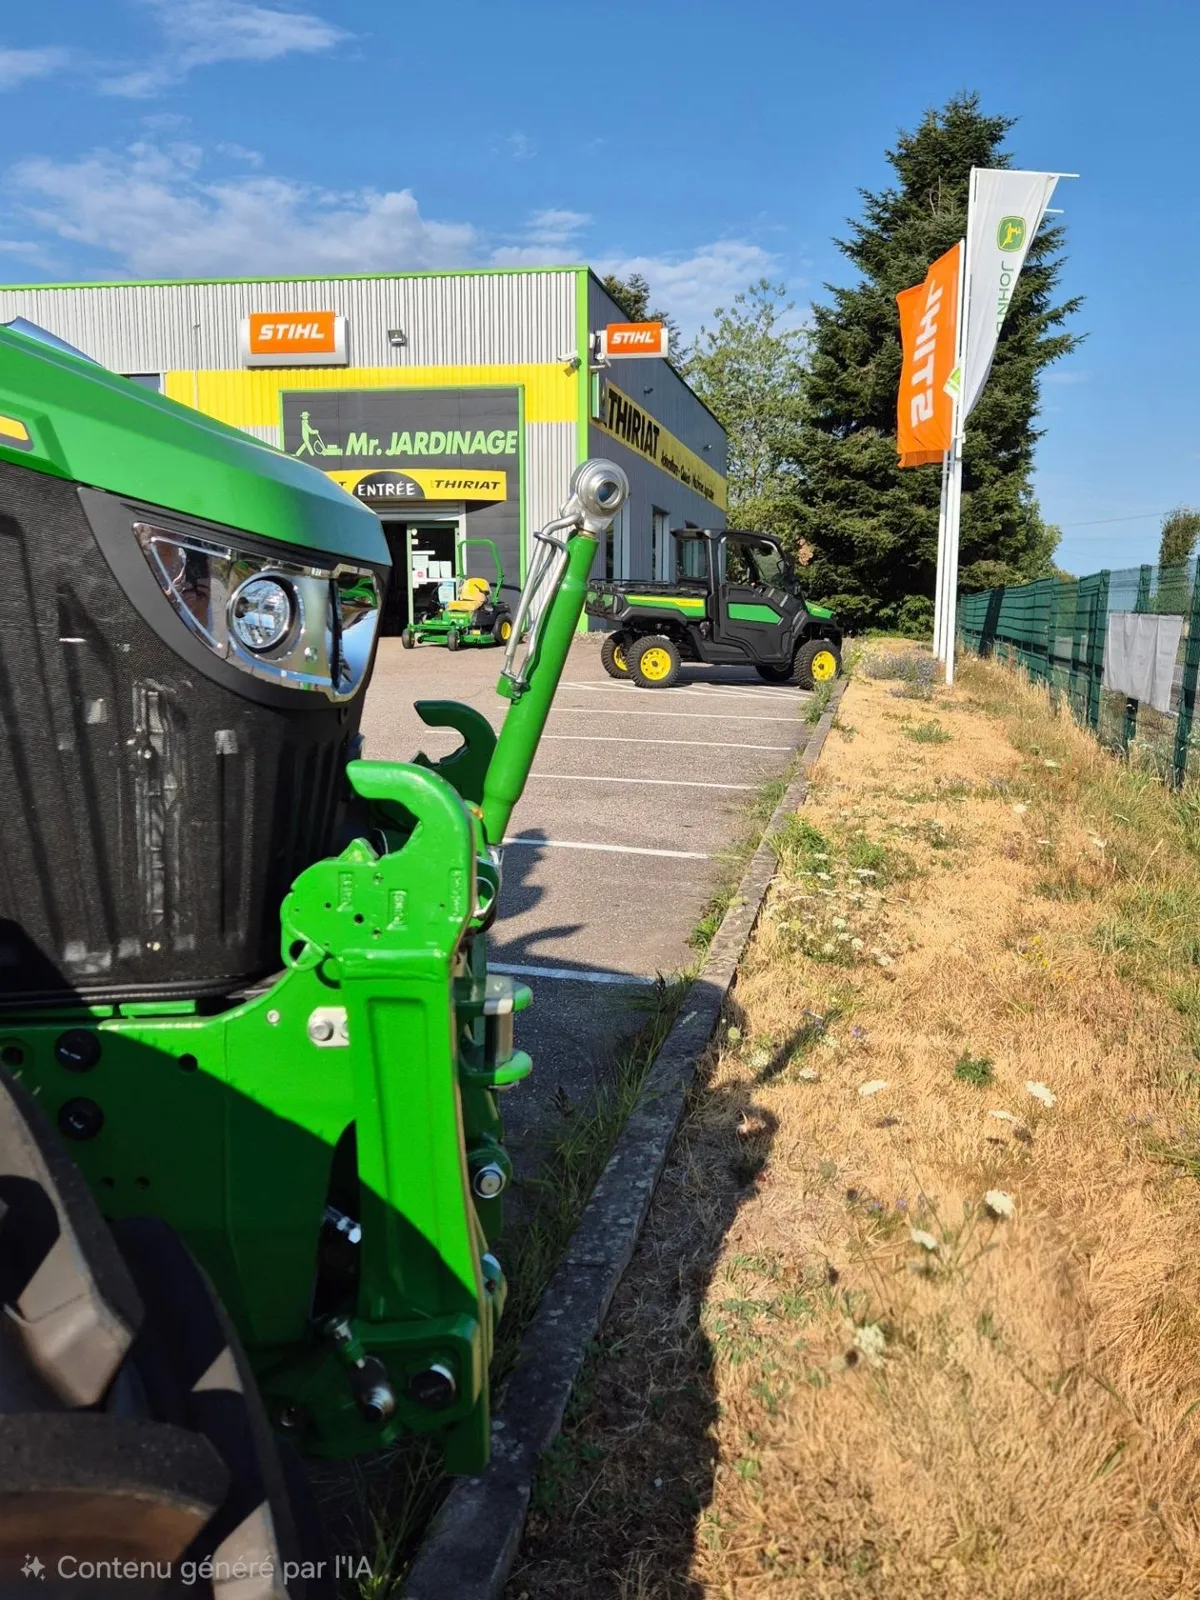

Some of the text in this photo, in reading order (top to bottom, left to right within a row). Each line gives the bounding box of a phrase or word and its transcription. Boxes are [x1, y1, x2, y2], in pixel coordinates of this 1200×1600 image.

[998, 261, 1014, 316] JOHN
[258, 323, 324, 340] STIHL
[611, 331, 654, 344] STIHL
[608, 388, 660, 459] THIRIAT
[346, 430, 518, 456] Mr. JARDINAGE
[357, 480, 415, 497] ENTRÉE
[434, 480, 501, 490] THIRIAT
